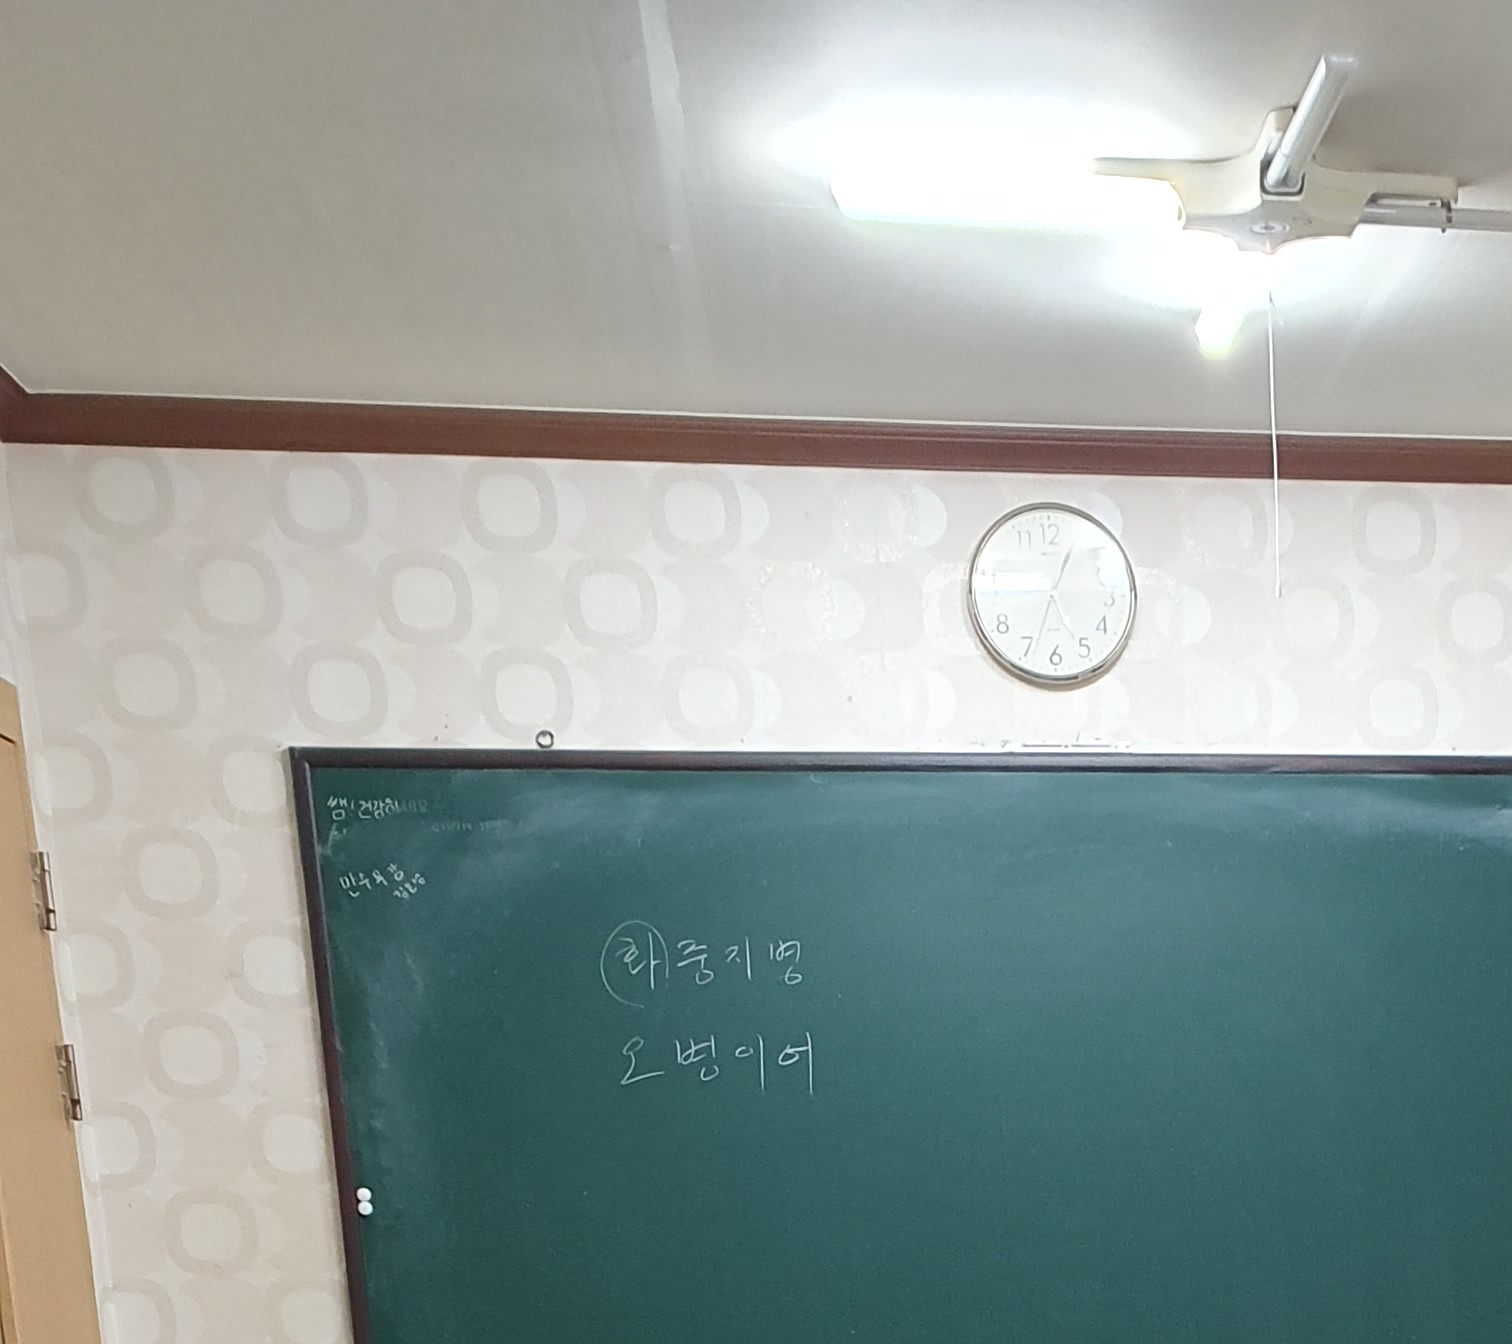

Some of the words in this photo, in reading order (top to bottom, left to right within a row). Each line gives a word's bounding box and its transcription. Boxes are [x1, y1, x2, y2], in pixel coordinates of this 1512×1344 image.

[1016, 530, 1032, 549] 11
[1039, 523, 1060, 545] 12
[996, 613, 1010, 635] 8
[1095, 615, 1108, 636] 4
[1020, 636, 1034, 658] 7
[1049, 644, 1063, 667] 6
[1078, 637, 1092, 659] 5
[620, 1031, 814, 1096] 오병이어
